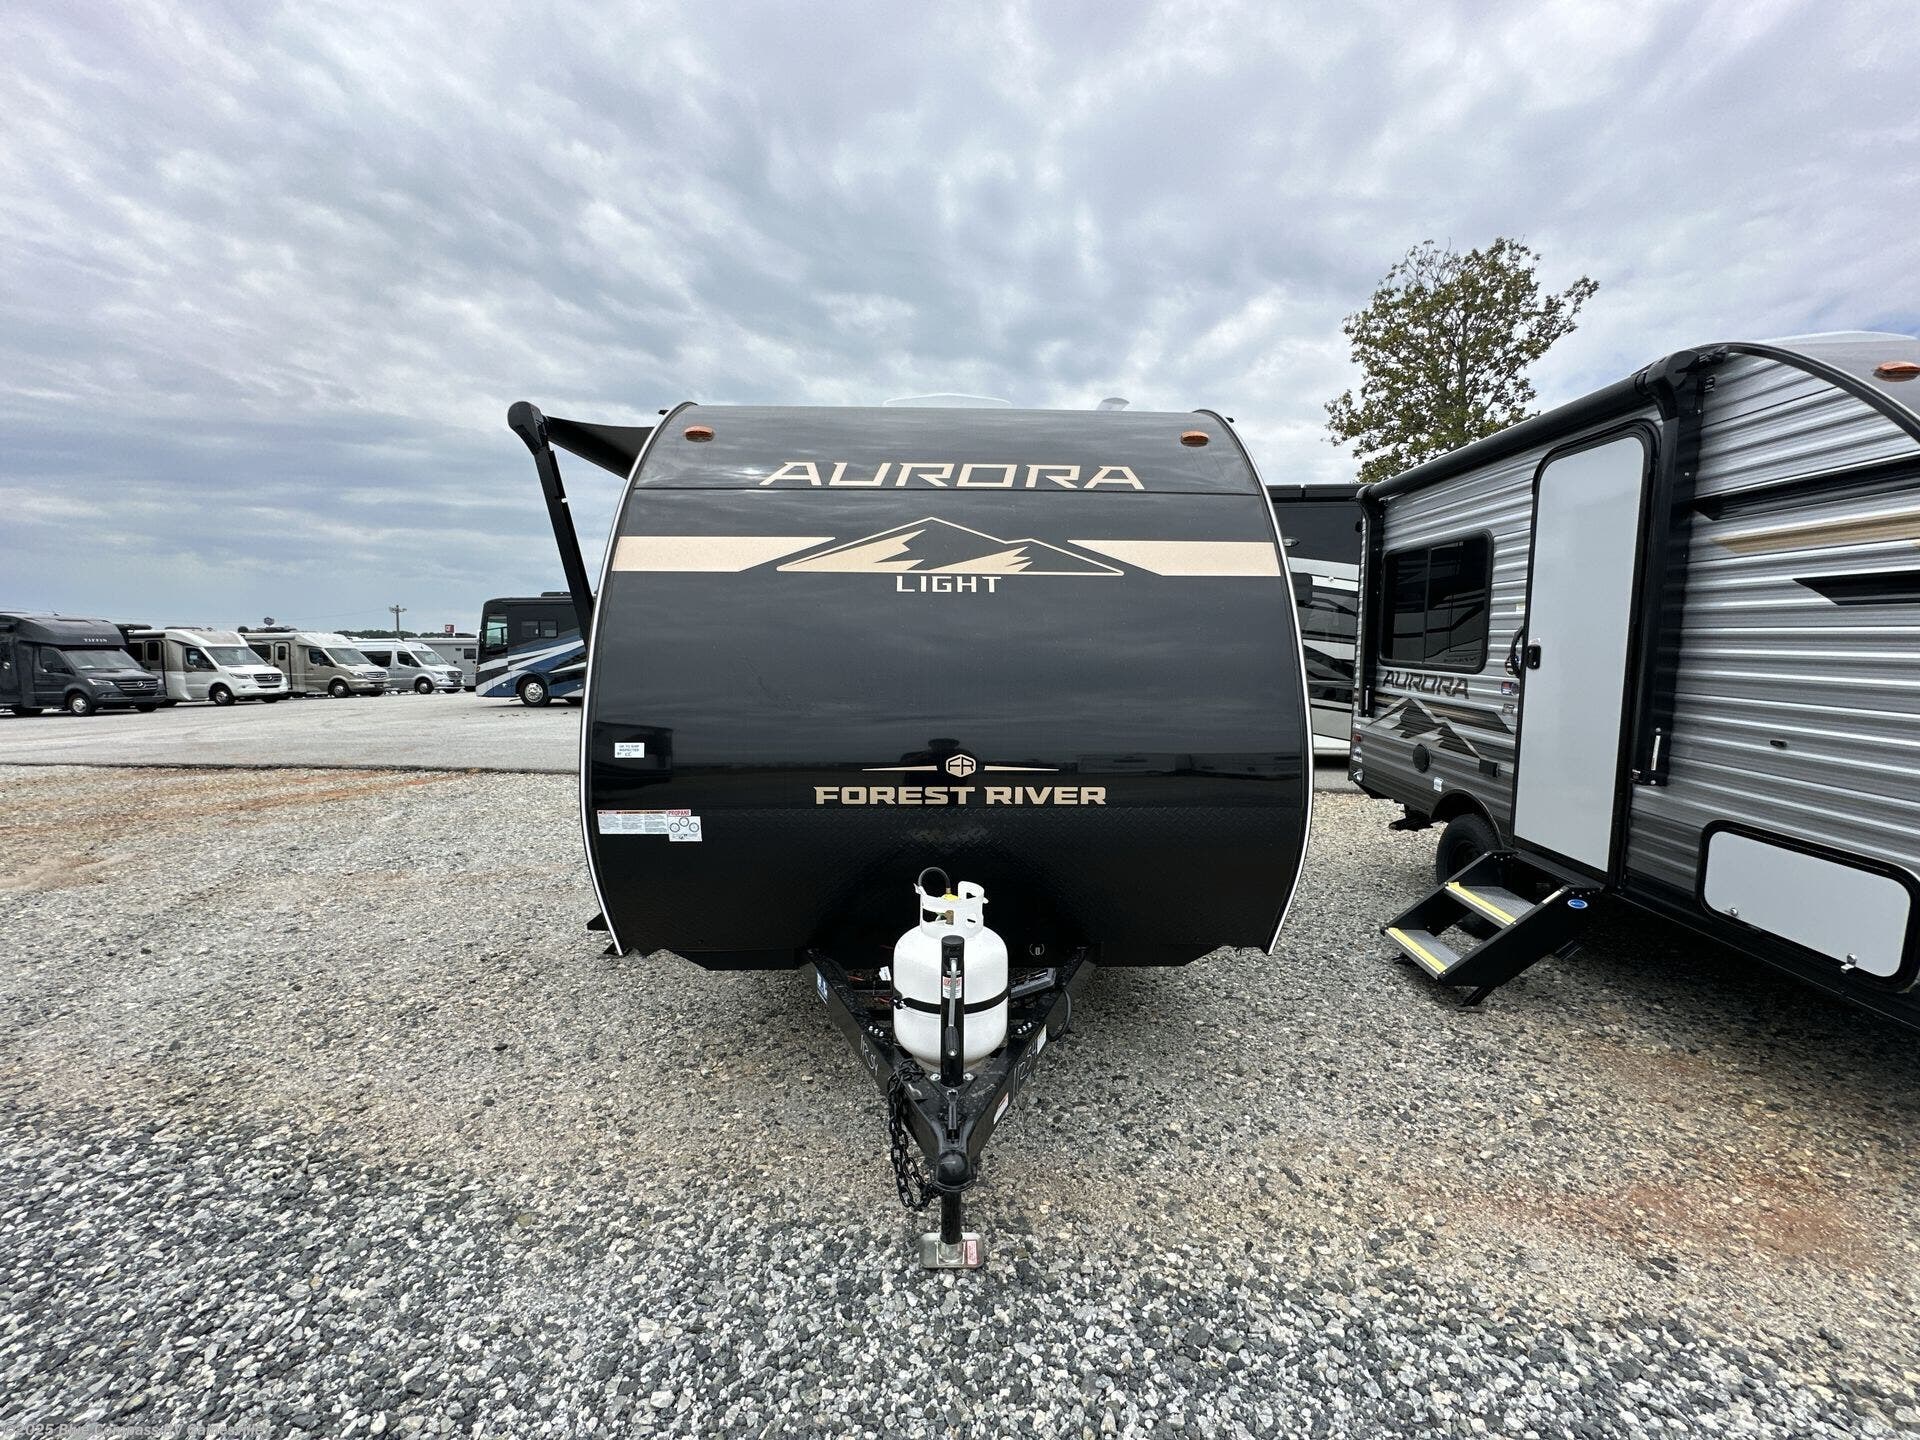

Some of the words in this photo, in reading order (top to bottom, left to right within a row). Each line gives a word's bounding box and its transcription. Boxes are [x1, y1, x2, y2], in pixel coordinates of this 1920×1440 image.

[758, 461, 1145, 490] AURORA
[895, 575, 1002, 593] LIGHT
[1382, 669, 1470, 700] AURORA
[813, 786, 976, 805] FOREST
[983, 786, 1107, 805] RIVER
